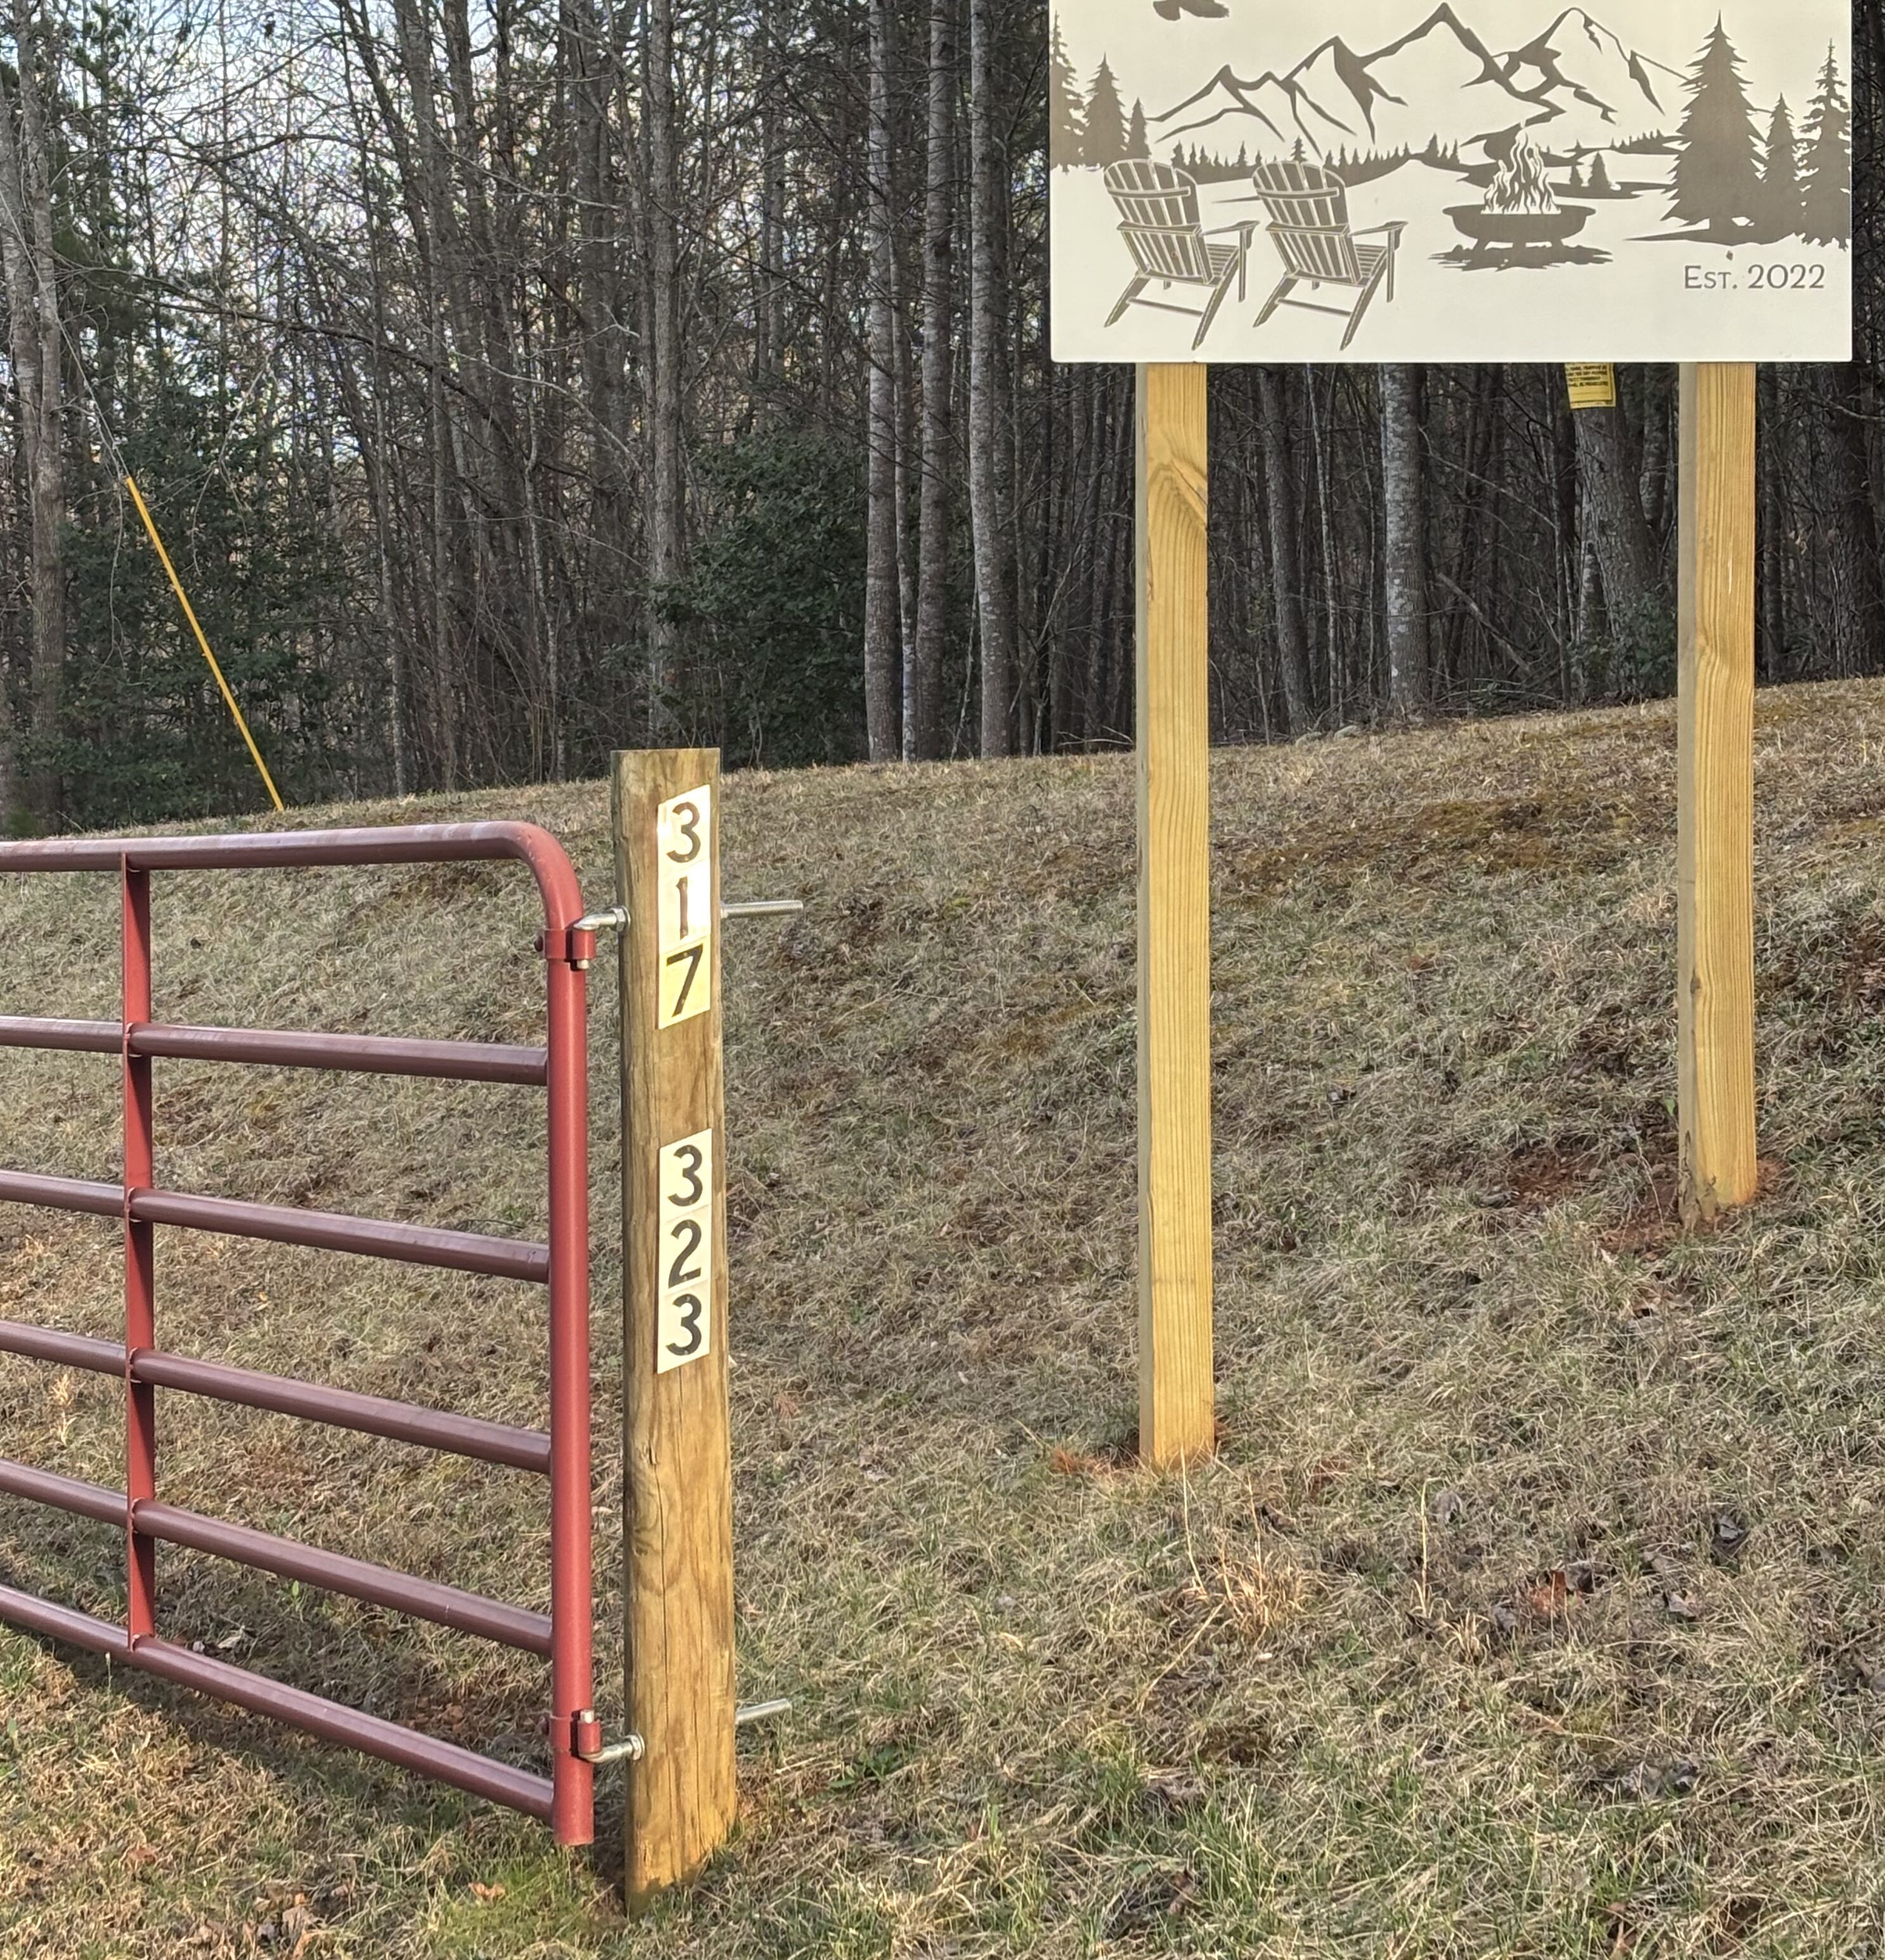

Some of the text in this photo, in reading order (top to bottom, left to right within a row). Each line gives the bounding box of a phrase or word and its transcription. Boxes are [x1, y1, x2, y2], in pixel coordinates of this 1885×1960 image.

[1747, 264, 1825, 289] 2022
[666, 801, 703, 1017] 317
[666, 1144, 703, 1356] 323
